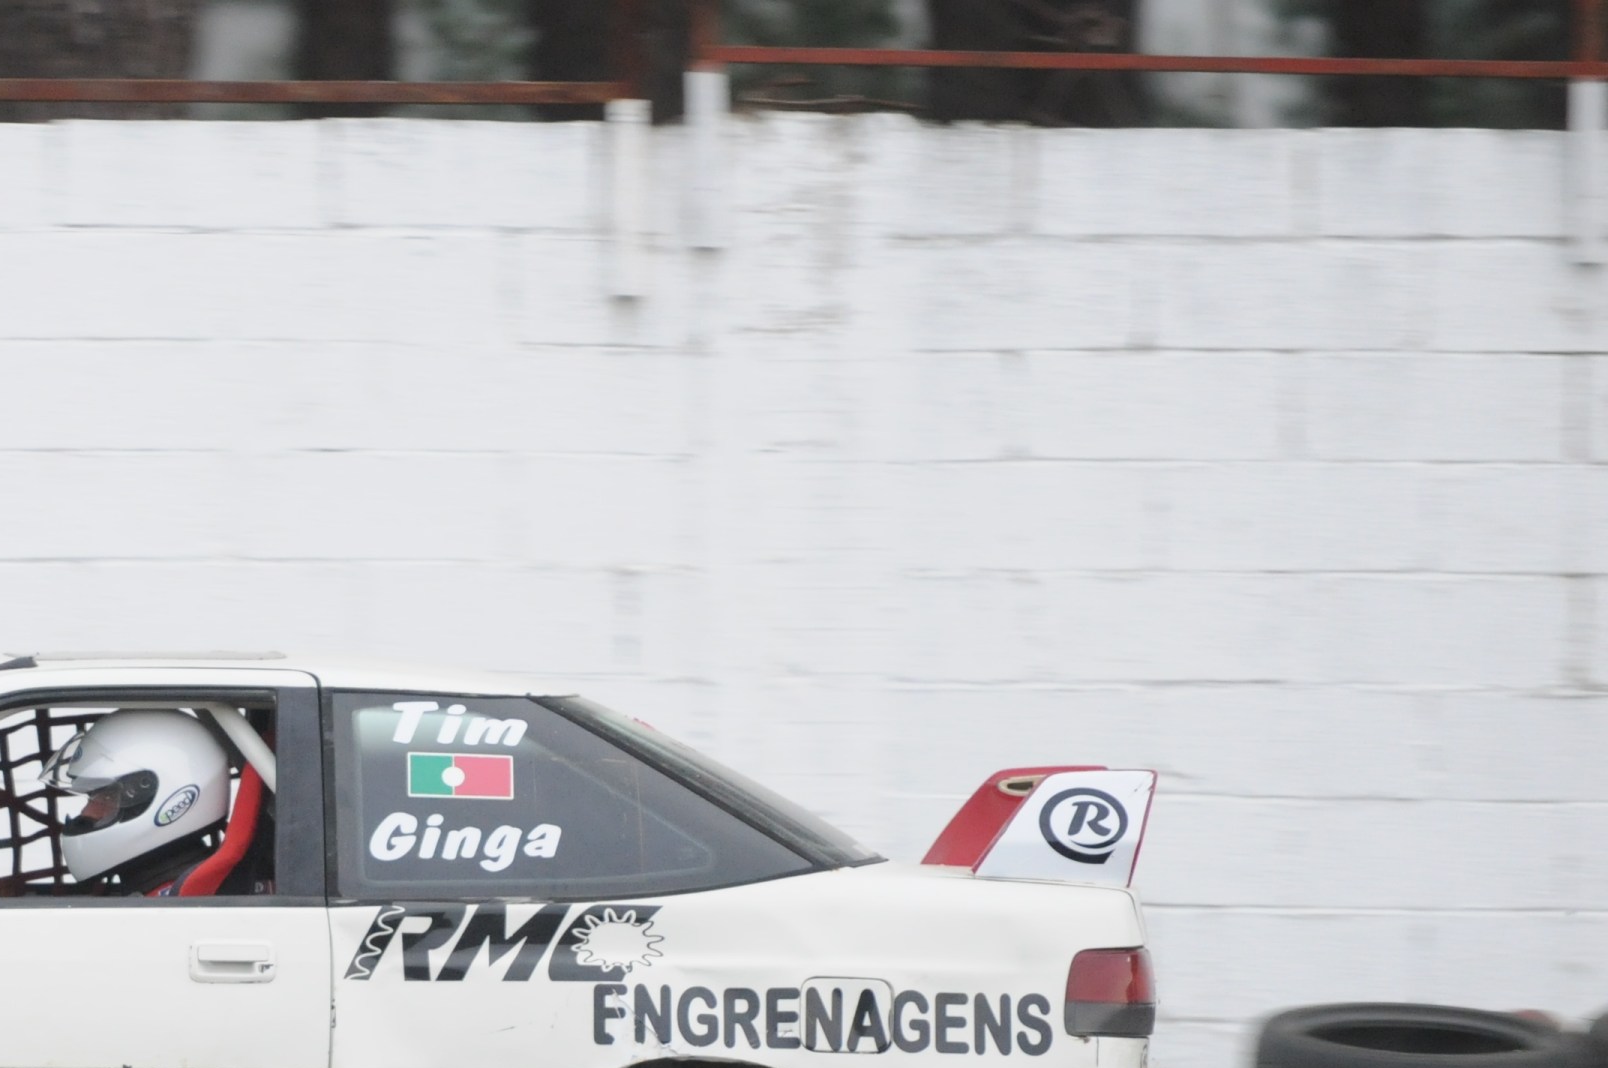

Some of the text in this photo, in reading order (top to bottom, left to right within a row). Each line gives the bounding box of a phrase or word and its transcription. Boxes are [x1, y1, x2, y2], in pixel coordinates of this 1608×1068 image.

[393, 701, 528, 747] Tim
[369, 812, 563, 872] Ginga
[594, 983, 1054, 1056] ENGRENAGENS
